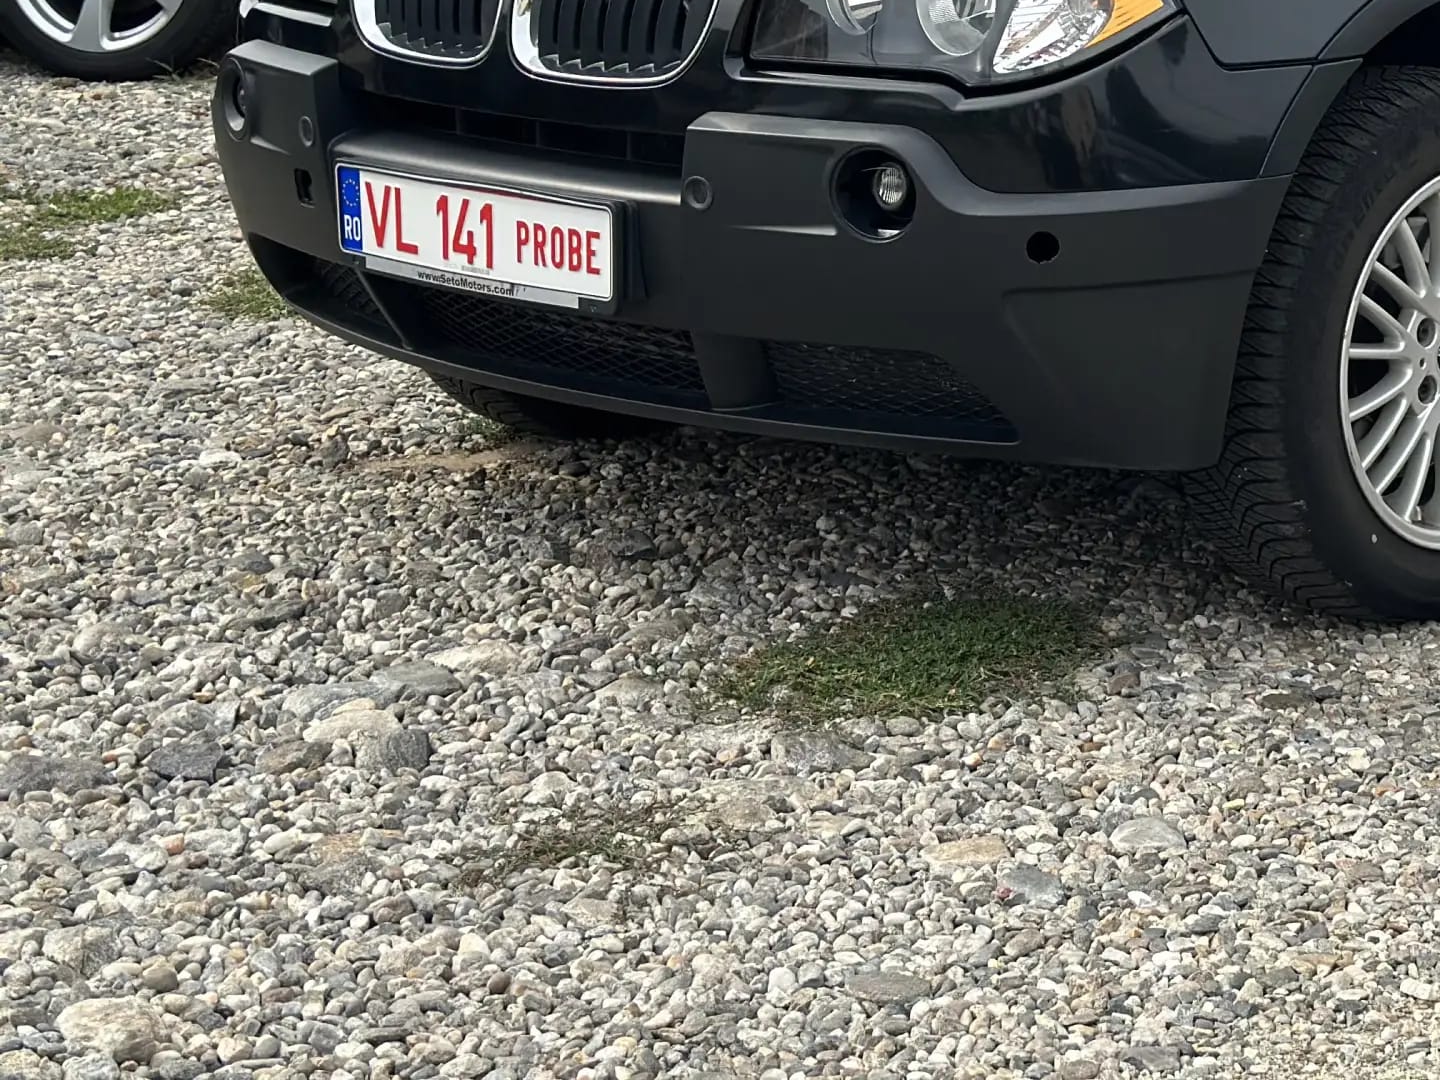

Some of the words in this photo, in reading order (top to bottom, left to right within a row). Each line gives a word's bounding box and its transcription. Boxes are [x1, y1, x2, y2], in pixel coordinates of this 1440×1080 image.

[344, 214, 361, 241] RO
[365, 181, 419, 255] VL
[436, 194, 494, 269] 141
[516, 220, 601, 275] PROBE
